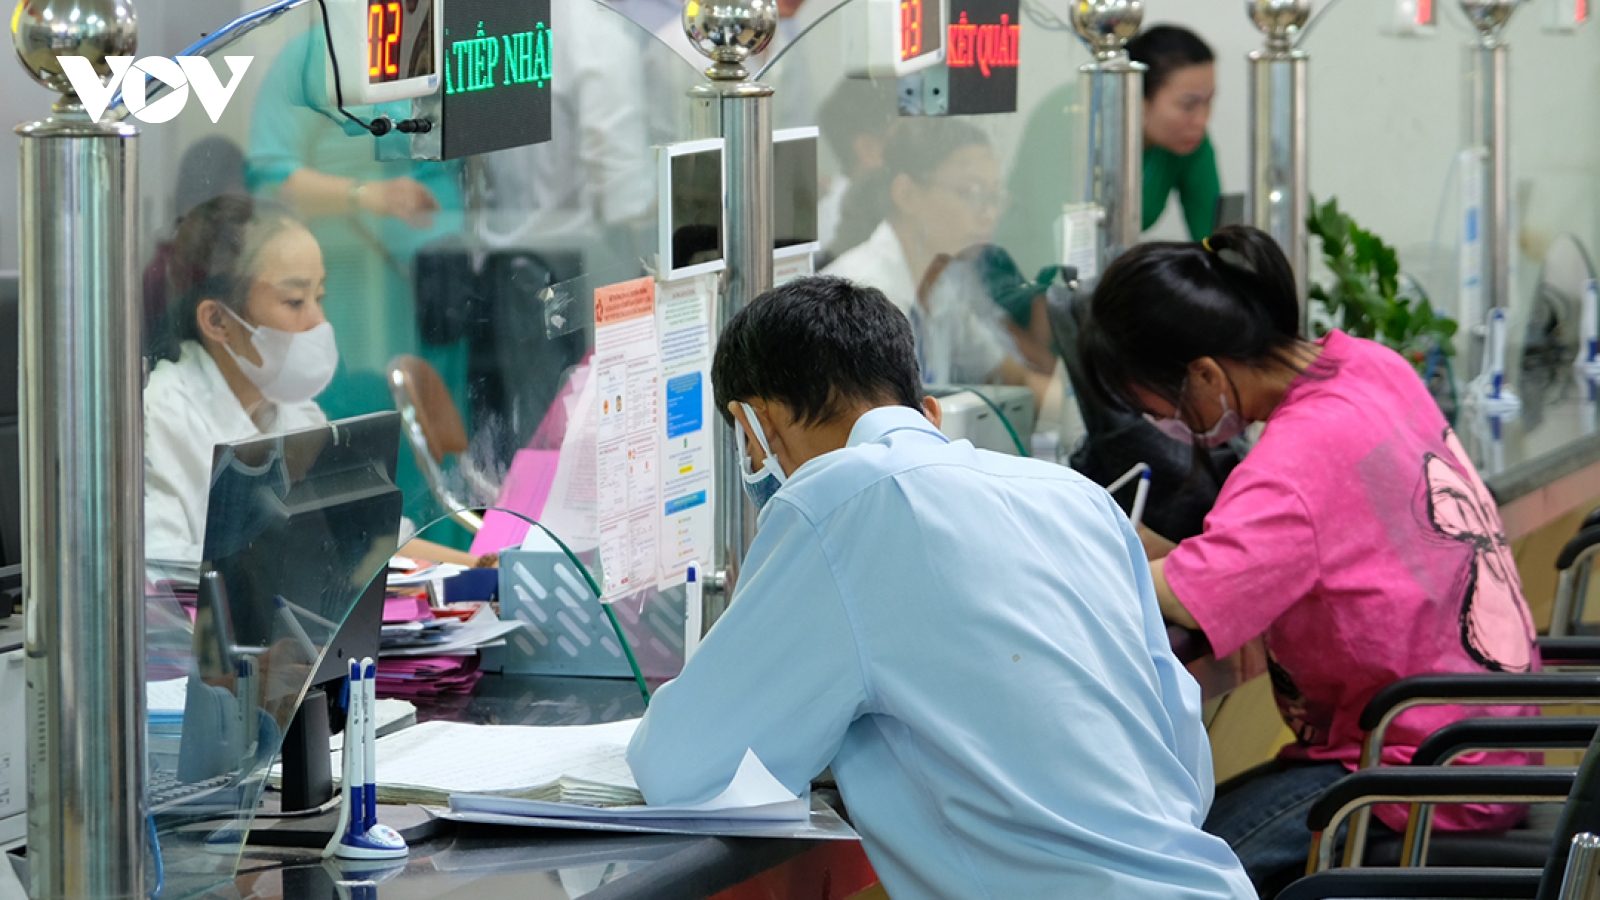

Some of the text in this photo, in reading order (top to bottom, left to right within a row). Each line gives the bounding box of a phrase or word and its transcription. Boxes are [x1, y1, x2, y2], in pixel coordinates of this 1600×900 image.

[368, 2, 402, 77] 02
[452, 21, 499, 93] TIẾP
[901, 0, 921, 61] 03
[947, 11, 977, 68] KẾT
